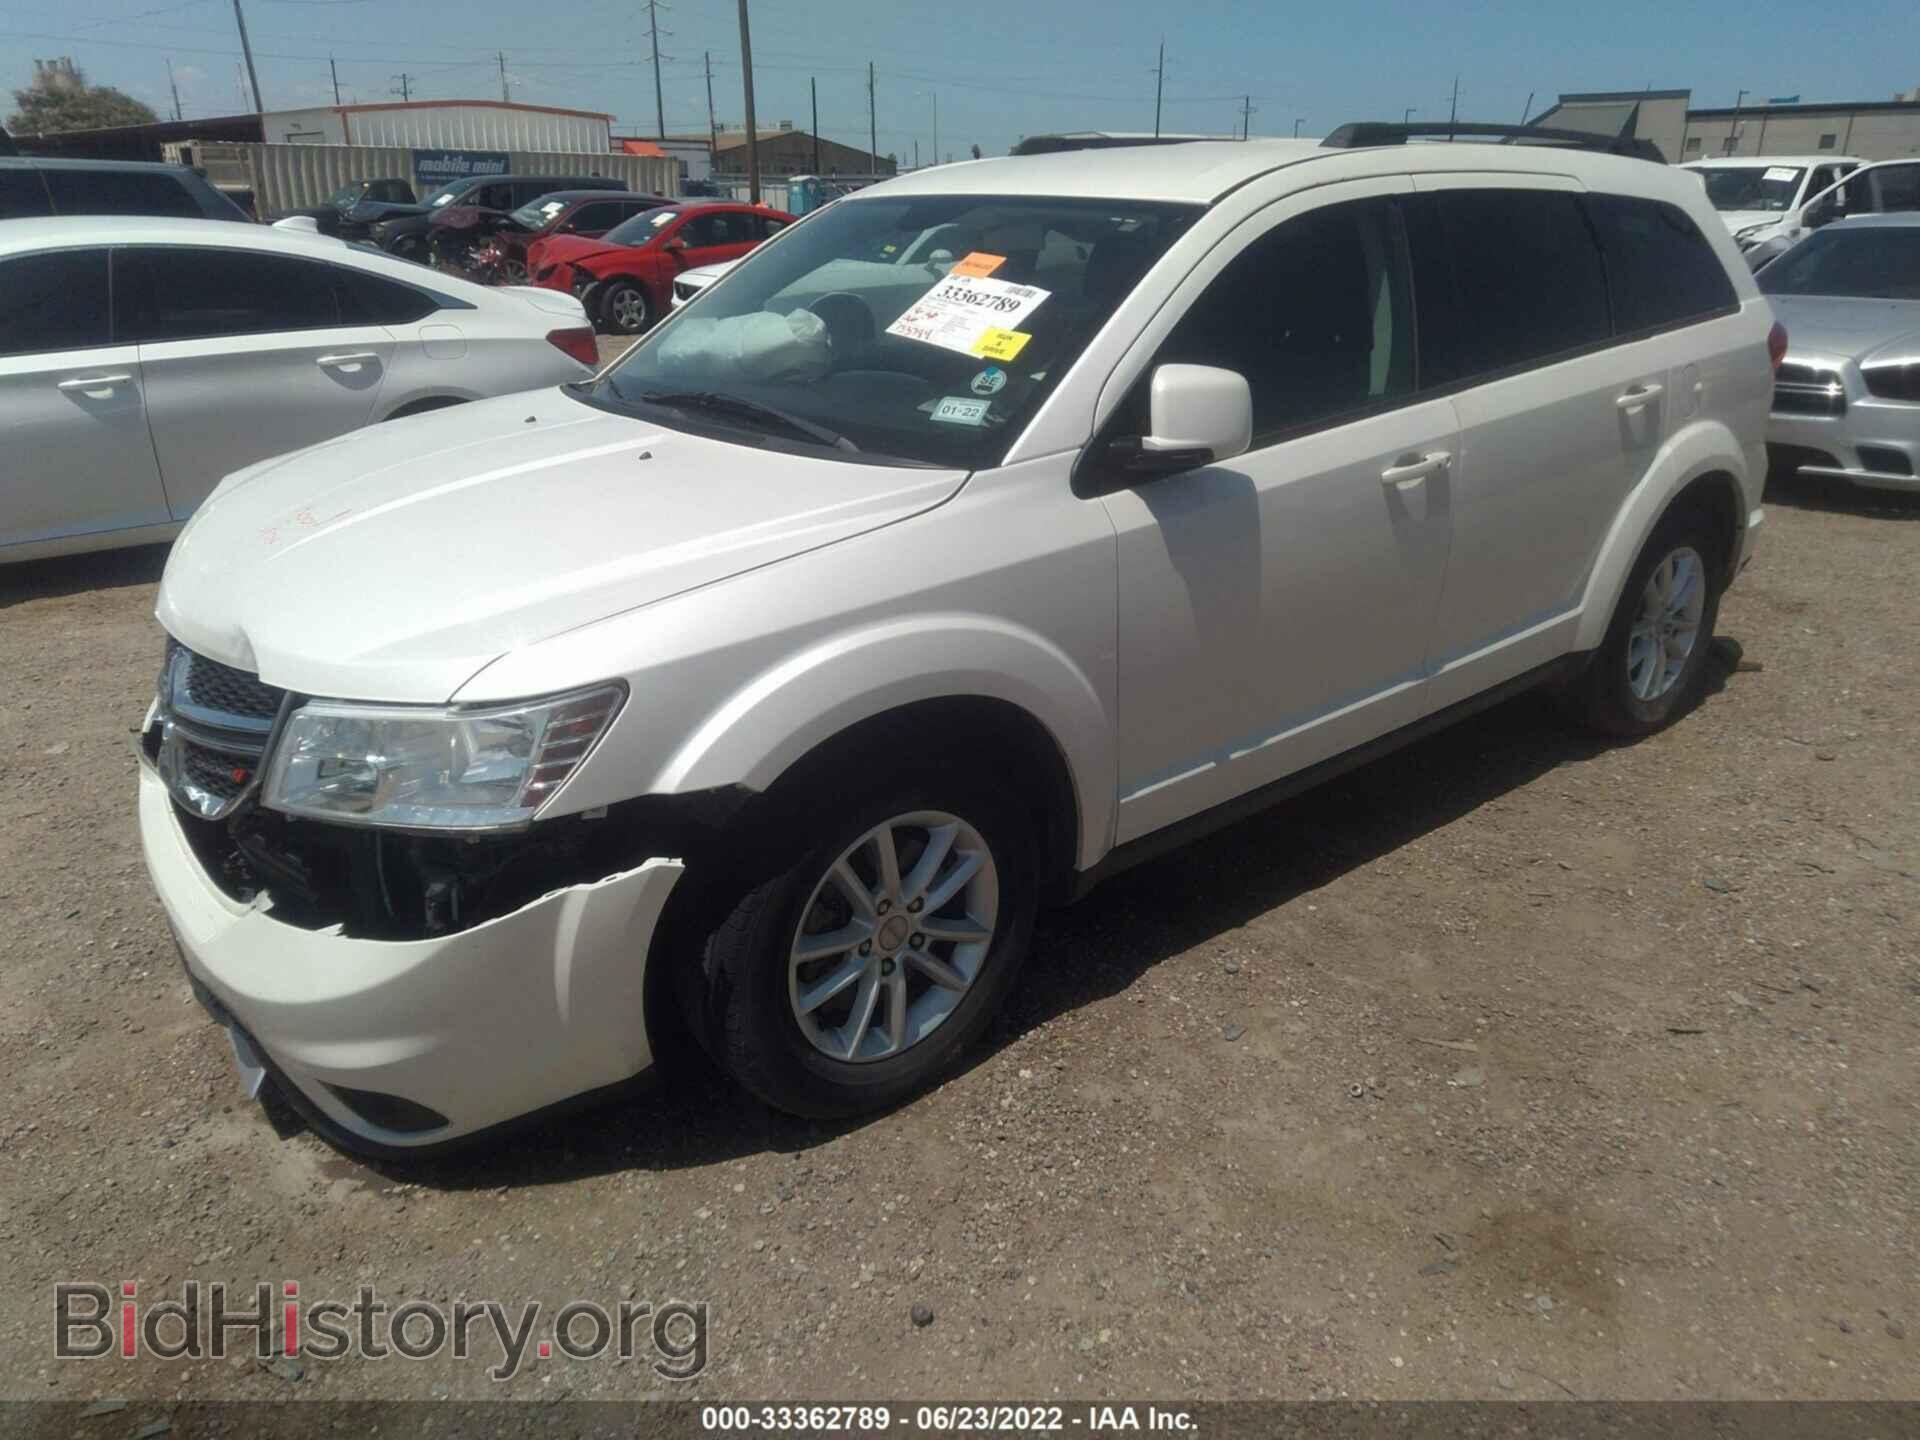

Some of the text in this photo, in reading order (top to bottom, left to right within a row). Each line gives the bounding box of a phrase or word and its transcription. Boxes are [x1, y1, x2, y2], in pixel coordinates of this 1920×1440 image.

[418, 155, 505, 173] mobile mini
[937, 285, 1022, 313] 33362789
[941, 405, 982, 418] 01-22
